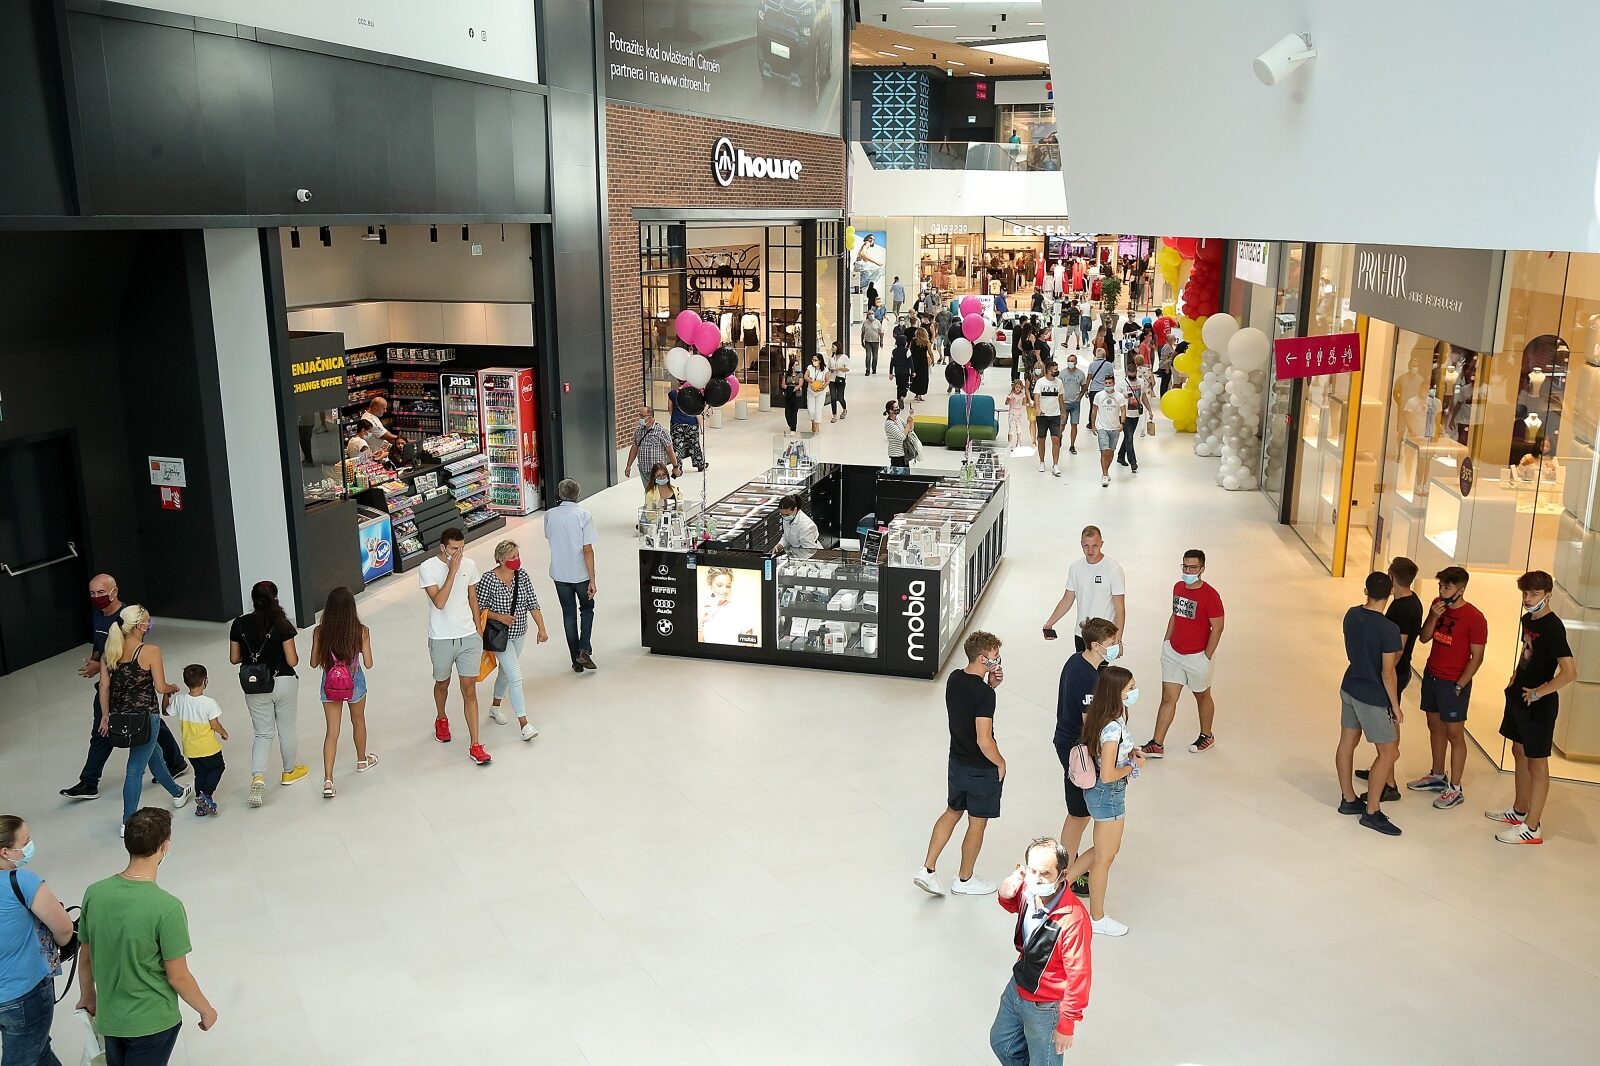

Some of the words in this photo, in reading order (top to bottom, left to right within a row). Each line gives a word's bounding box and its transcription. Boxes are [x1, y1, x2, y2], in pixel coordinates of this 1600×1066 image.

[609, 31, 645, 57] Potražite
[645, 39, 660, 60] kod
[661, 44, 696, 69] ovlaštenih
[697, 53, 721, 74] Citroën
[610, 62, 644, 80] partnera
[645, 65, 648, 81] i
[649, 70, 660, 83] na
[660, 73, 711, 93] www.citroen.hr
[738, 149, 803, 180] house
[320, 376, 343, 388] OFFICE
[651, 585, 677, 594] Ferrari
[901, 580, 926, 661] mobia
